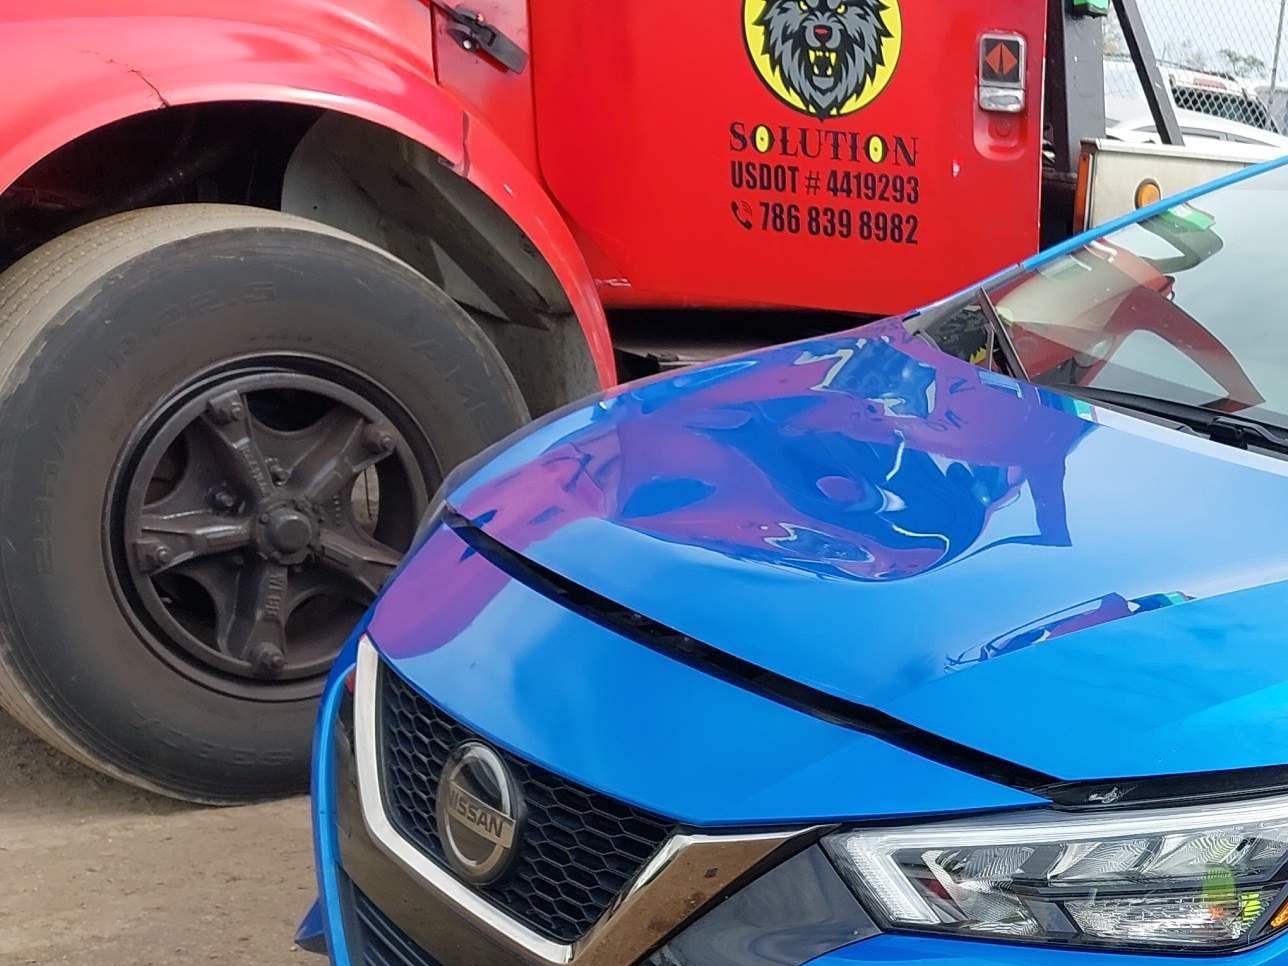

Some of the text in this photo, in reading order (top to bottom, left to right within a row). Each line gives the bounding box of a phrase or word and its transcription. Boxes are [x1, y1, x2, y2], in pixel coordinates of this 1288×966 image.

[729, 121, 919, 168] SOLUTION
[730, 160, 920, 205] USDOT # 4419293
[760, 201, 919, 246] 786 839 8982
